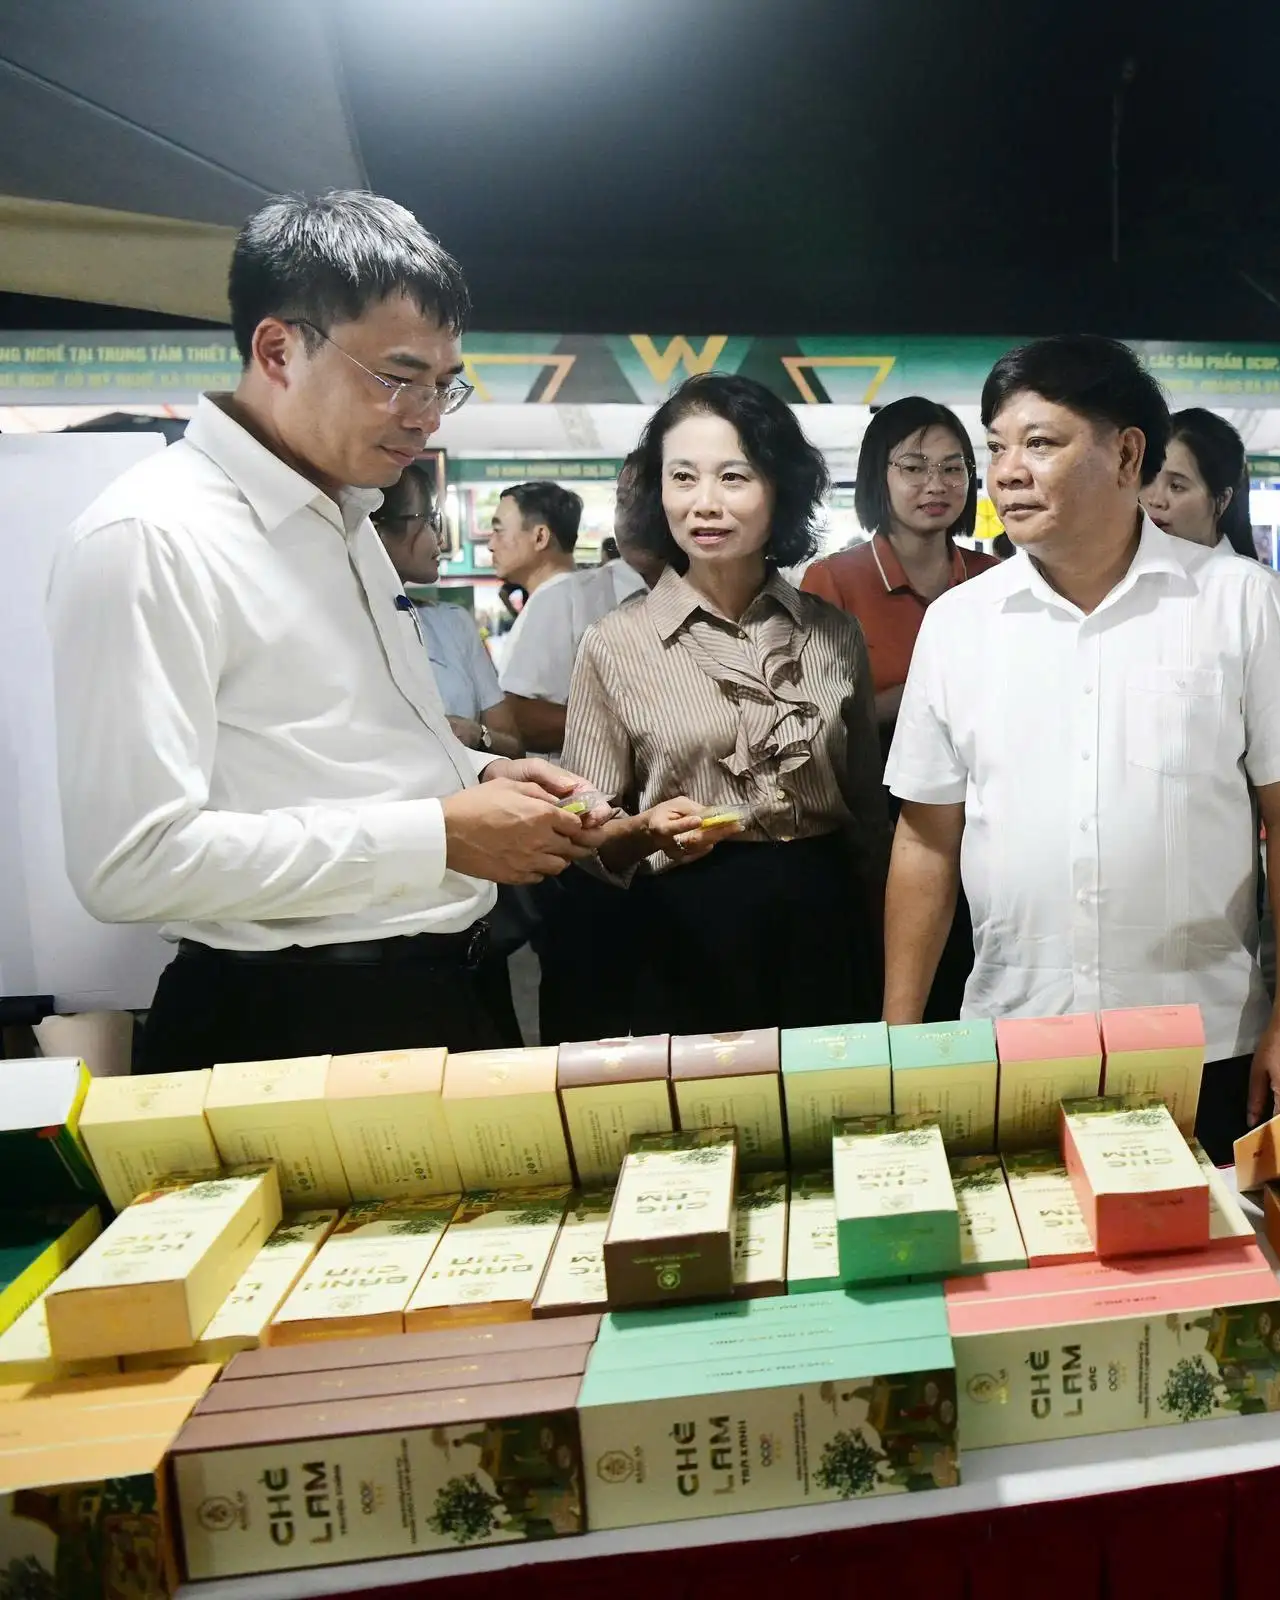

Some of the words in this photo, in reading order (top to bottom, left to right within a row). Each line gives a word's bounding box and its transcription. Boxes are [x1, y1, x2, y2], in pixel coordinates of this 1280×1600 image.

[1025, 1350, 1051, 1419] CHÈ
[1062, 1345, 1083, 1418] LAM
[669, 1421, 699, 1496] CHÈ
[709, 1415, 736, 1495] LAM
[258, 1467, 295, 1546] CHÈ
[302, 1460, 333, 1544] LAM
